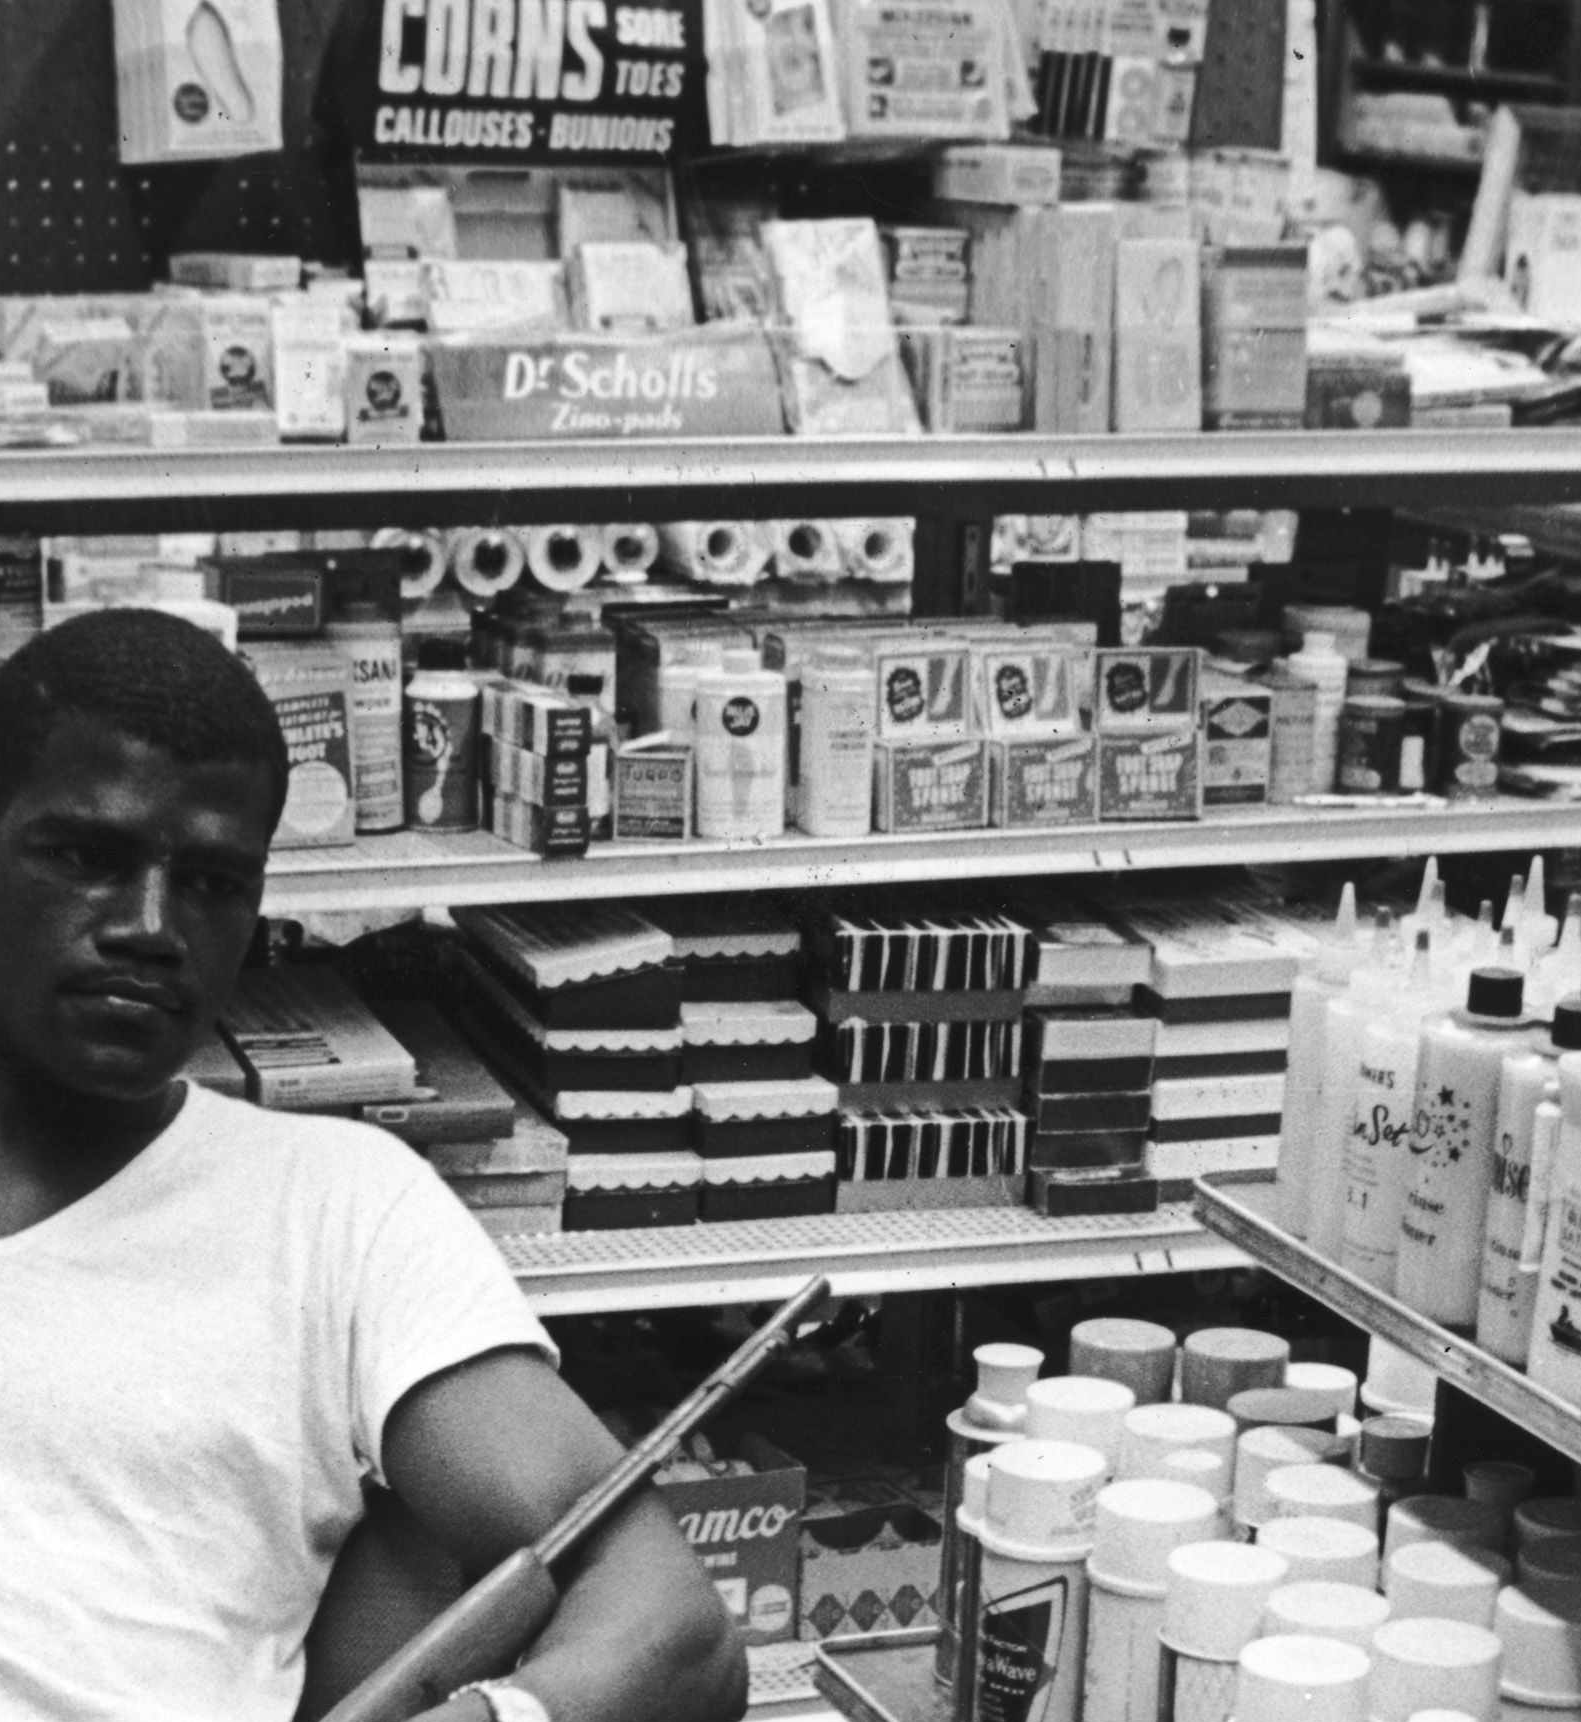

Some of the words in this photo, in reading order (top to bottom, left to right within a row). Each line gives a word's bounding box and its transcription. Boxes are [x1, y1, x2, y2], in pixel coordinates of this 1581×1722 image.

[378, 0, 608, 101] CORNS
[615, 59, 685, 98] TOES
[375, 106, 535, 148] CALLOUSES
[548, 112, 675, 152] BUNIONS
